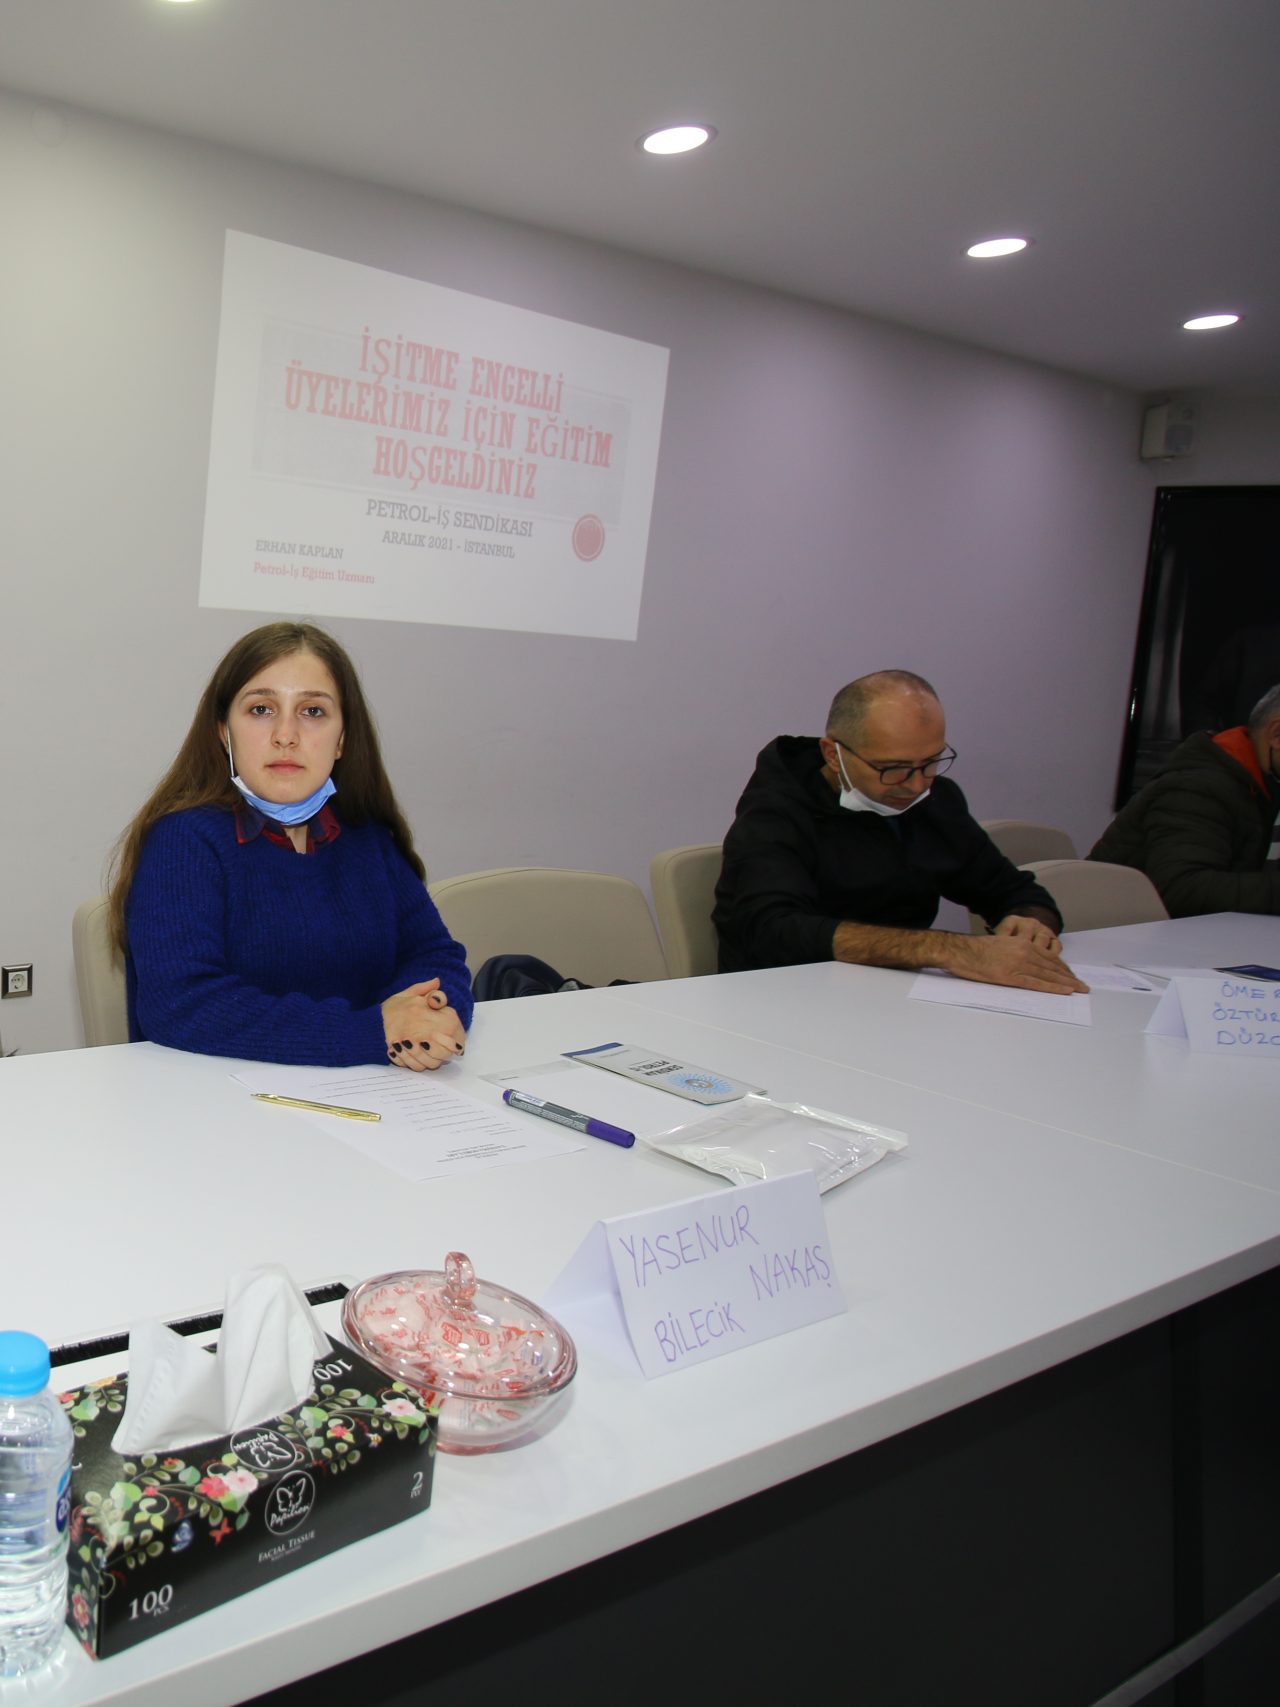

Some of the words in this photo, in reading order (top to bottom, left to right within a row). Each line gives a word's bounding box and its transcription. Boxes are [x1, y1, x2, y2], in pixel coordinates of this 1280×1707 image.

[358, 326, 460, 391] İŞİTME
[468, 356, 565, 414] ENGELLİ
[284, 359, 451, 438] ÜYELERİMİZ
[461, 400, 517, 451] İÇİN
[524, 412, 614, 469] EĞİTİM
[372, 434, 538, 500] HOŞGELDİNİZ
[365, 498, 450, 530] PETROL-İŞ
[453, 510, 534, 538] SENDİKASI
[255, 539, 297, 555] ERHAN
[298, 543, 344, 560] KAPLAN
[381, 530, 427, 548] ARALIK
[428, 535, 453, 551] 2021
[464, 538, 516, 559] İSTANBUL
[618, 1205, 760, 1289] YASENUR
[748, 1244, 832, 1301] NAKAŞ
[653, 1301, 747, 1363] BİLECİK
[313, 1358, 353, 1380] 100
[412, 1471, 423, 1491] 2
[129, 1584, 174, 1620] 100
